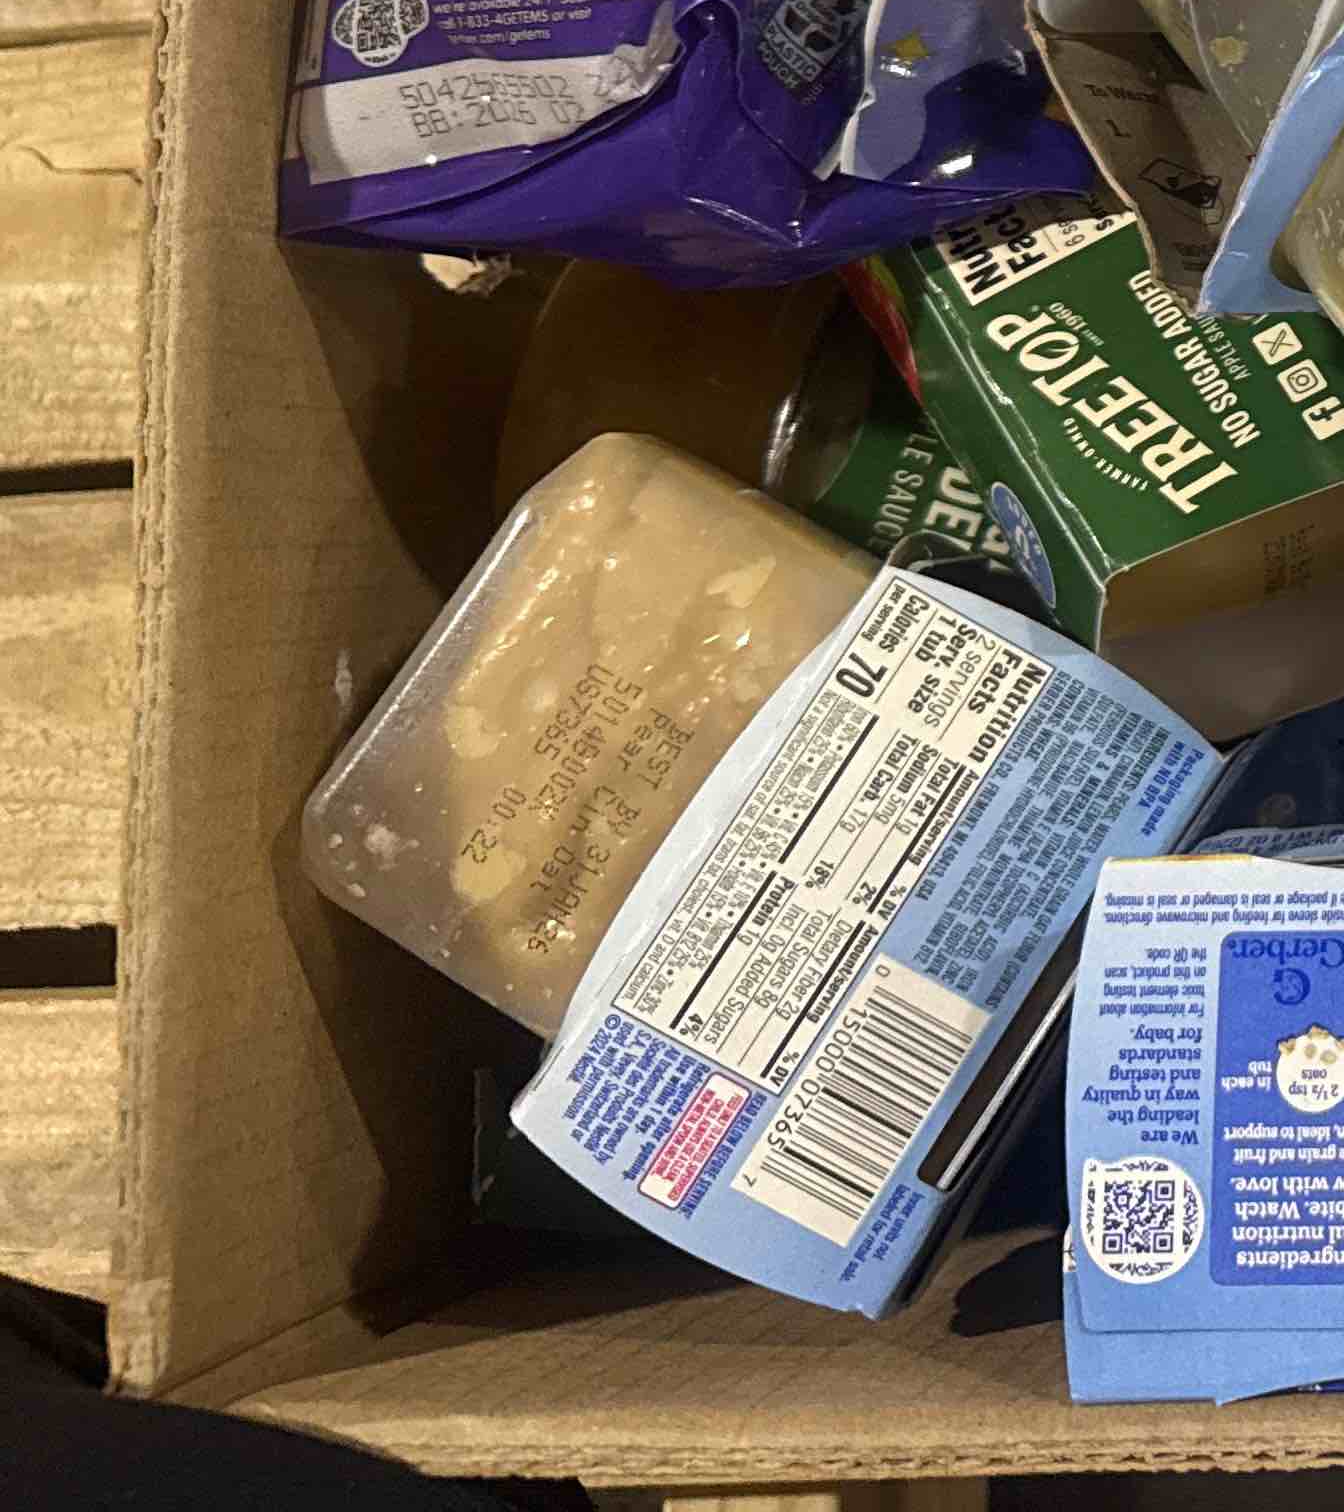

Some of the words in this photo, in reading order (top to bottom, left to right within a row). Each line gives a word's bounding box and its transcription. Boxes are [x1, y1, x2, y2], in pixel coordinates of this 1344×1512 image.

[1128, 270, 1192, 340] ADDED
[1173, 337, 1238, 414] SUGAR
[1221, 410, 1262, 448] NO
[877, 594, 930, 654] Calories
[939, 615, 957, 630] 1
[914, 630, 947, 663] tub
[933, 622, 978, 669] Serv.
[835, 652, 888, 699] 70
[907, 674, 940, 714] size
[967, 647, 1023, 715] Facts
[967, 662, 1048, 764] Nutrition
[616, 707, 672, 772] Pear
[638, 724, 696, 791] BEST
[607, 798, 642, 838] BY
[1230, 1174, 1279, 1194] love.
[1283, 1174, 1329, 1194] with
[1234, 1199, 1300, 1221] Watch
[1232, 1223, 1325, 1245] nutrition
